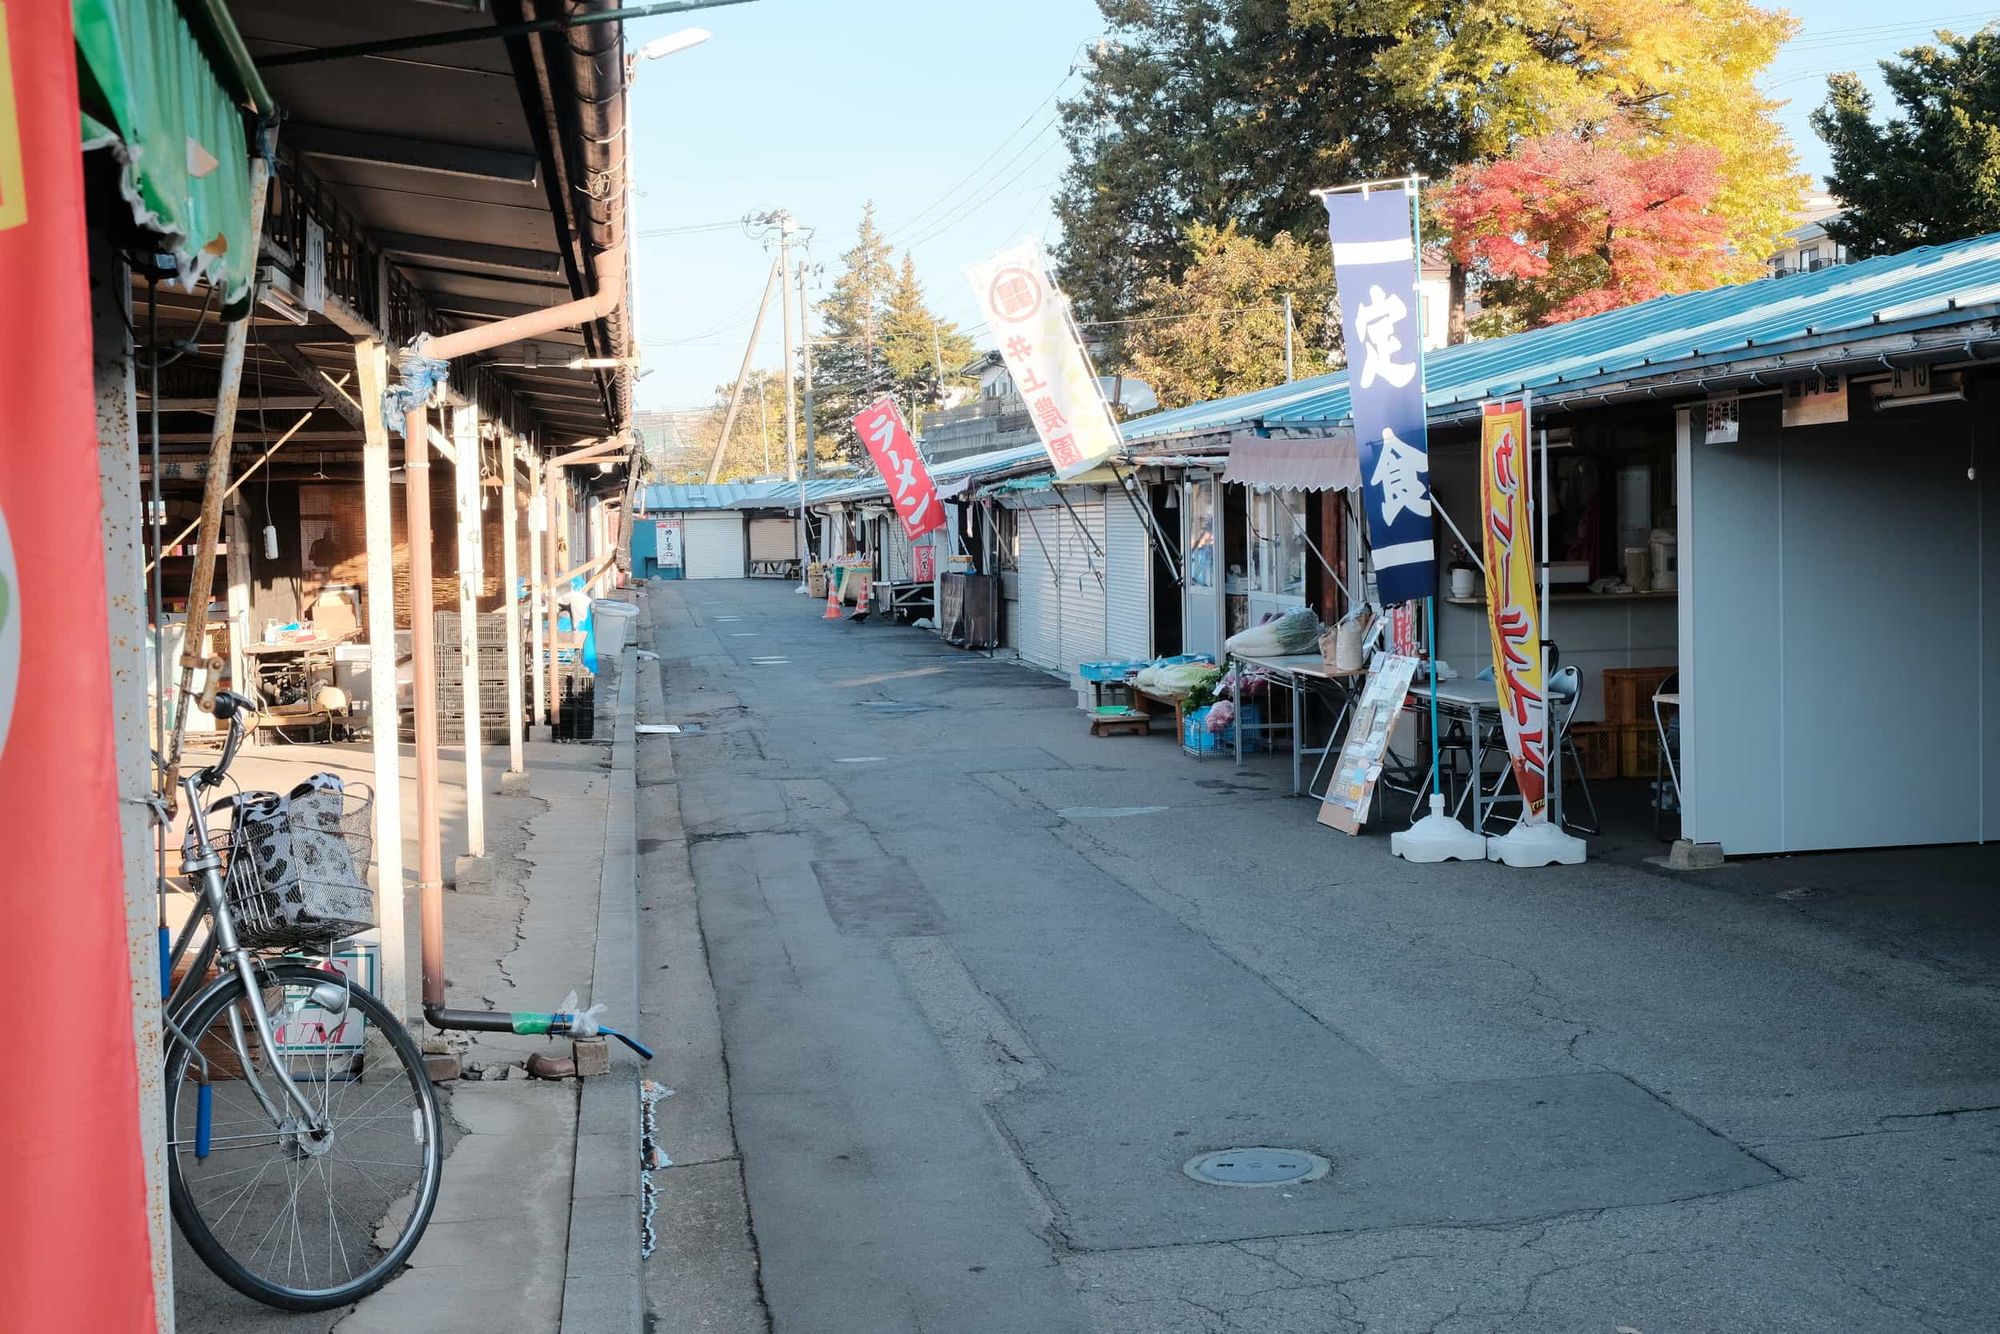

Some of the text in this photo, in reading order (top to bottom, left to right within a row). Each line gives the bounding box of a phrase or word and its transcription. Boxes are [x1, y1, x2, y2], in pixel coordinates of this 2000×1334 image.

[869, 414, 930, 525] ラーメン
[1355, 285, 1432, 526] 定食
